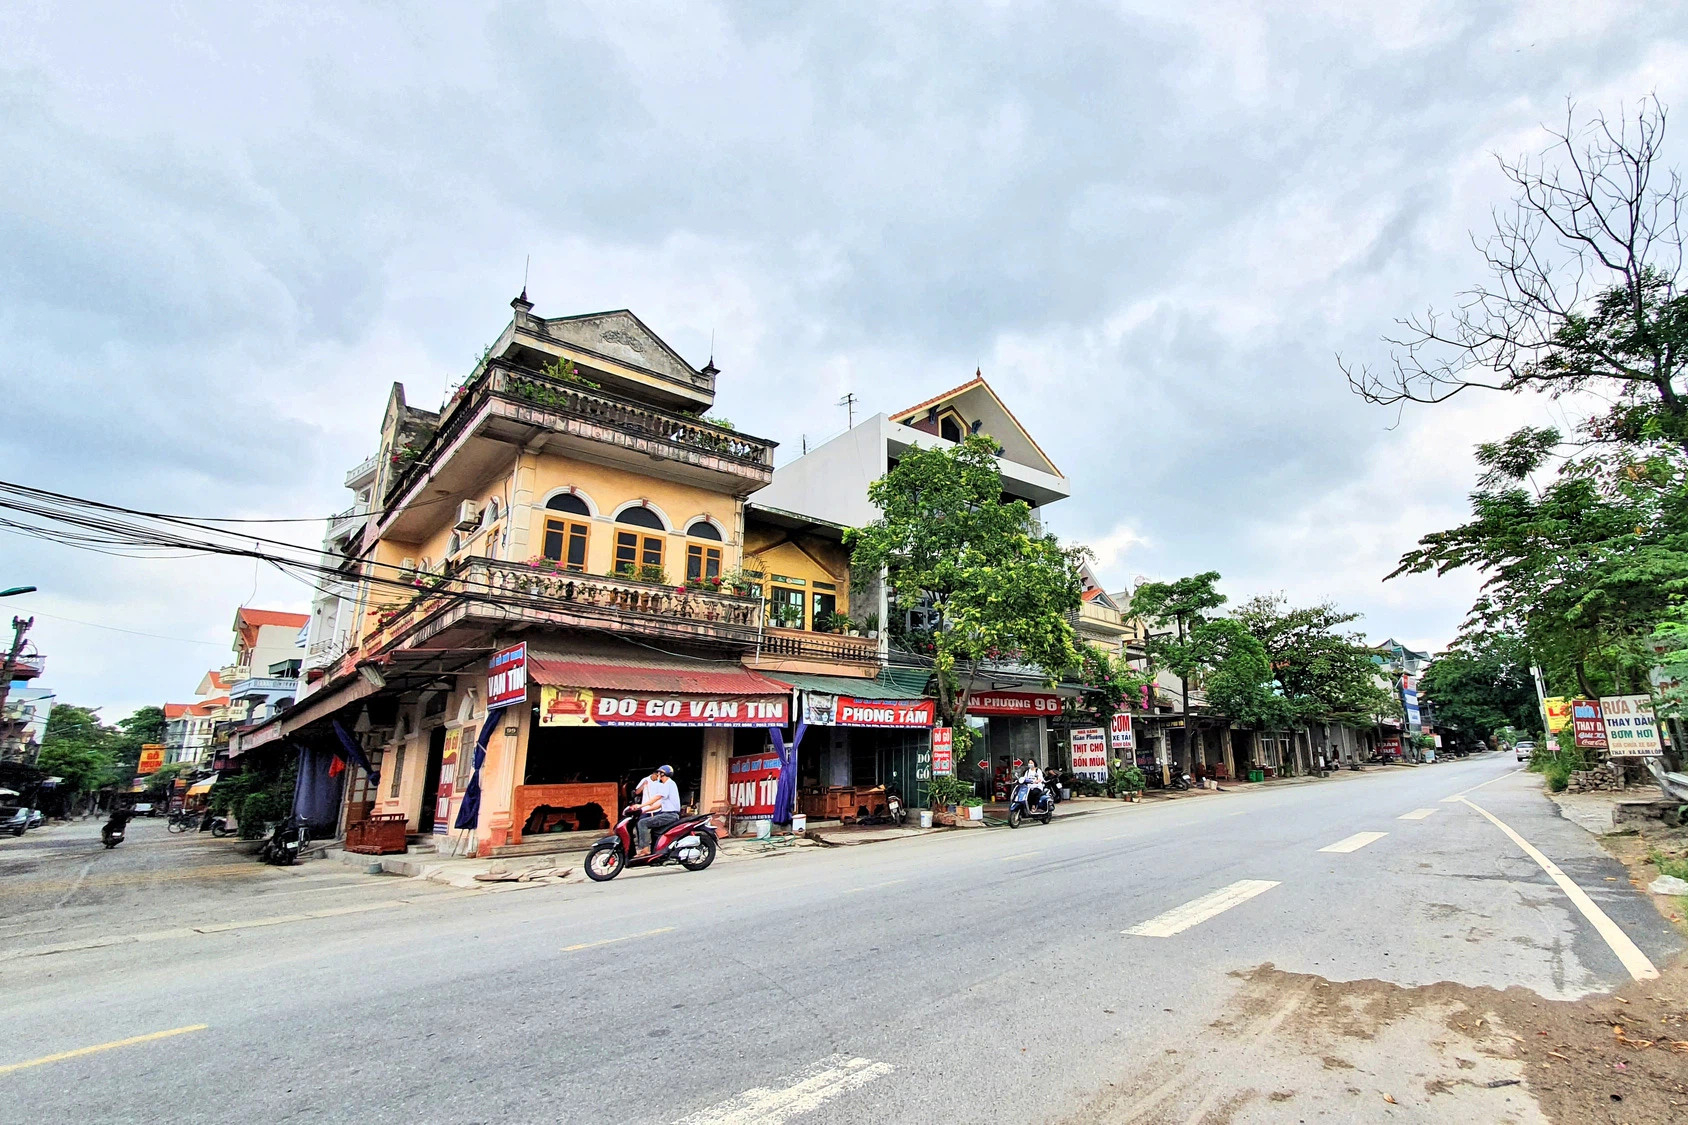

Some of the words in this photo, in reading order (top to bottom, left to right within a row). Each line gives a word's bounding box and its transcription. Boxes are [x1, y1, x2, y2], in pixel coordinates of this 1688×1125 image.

[488, 670, 506, 701] VẠN
[507, 664, 525, 692] TÍN
[689, 700, 739, 721] VẠN
[745, 699, 783, 718] TÍN
[1034, 698, 1058, 711] 96
[842, 706, 896, 723] PHONG
[898, 708, 928, 723] TÁM
[1112, 715, 1130, 733] CƠM
[1576, 721, 1595, 731] THAY
[1606, 718, 1631, 727] THAY
[1611, 729, 1634, 739] BƠM
[1073, 743, 1088, 754] THỊT
[729, 781, 756, 813] VẠN
